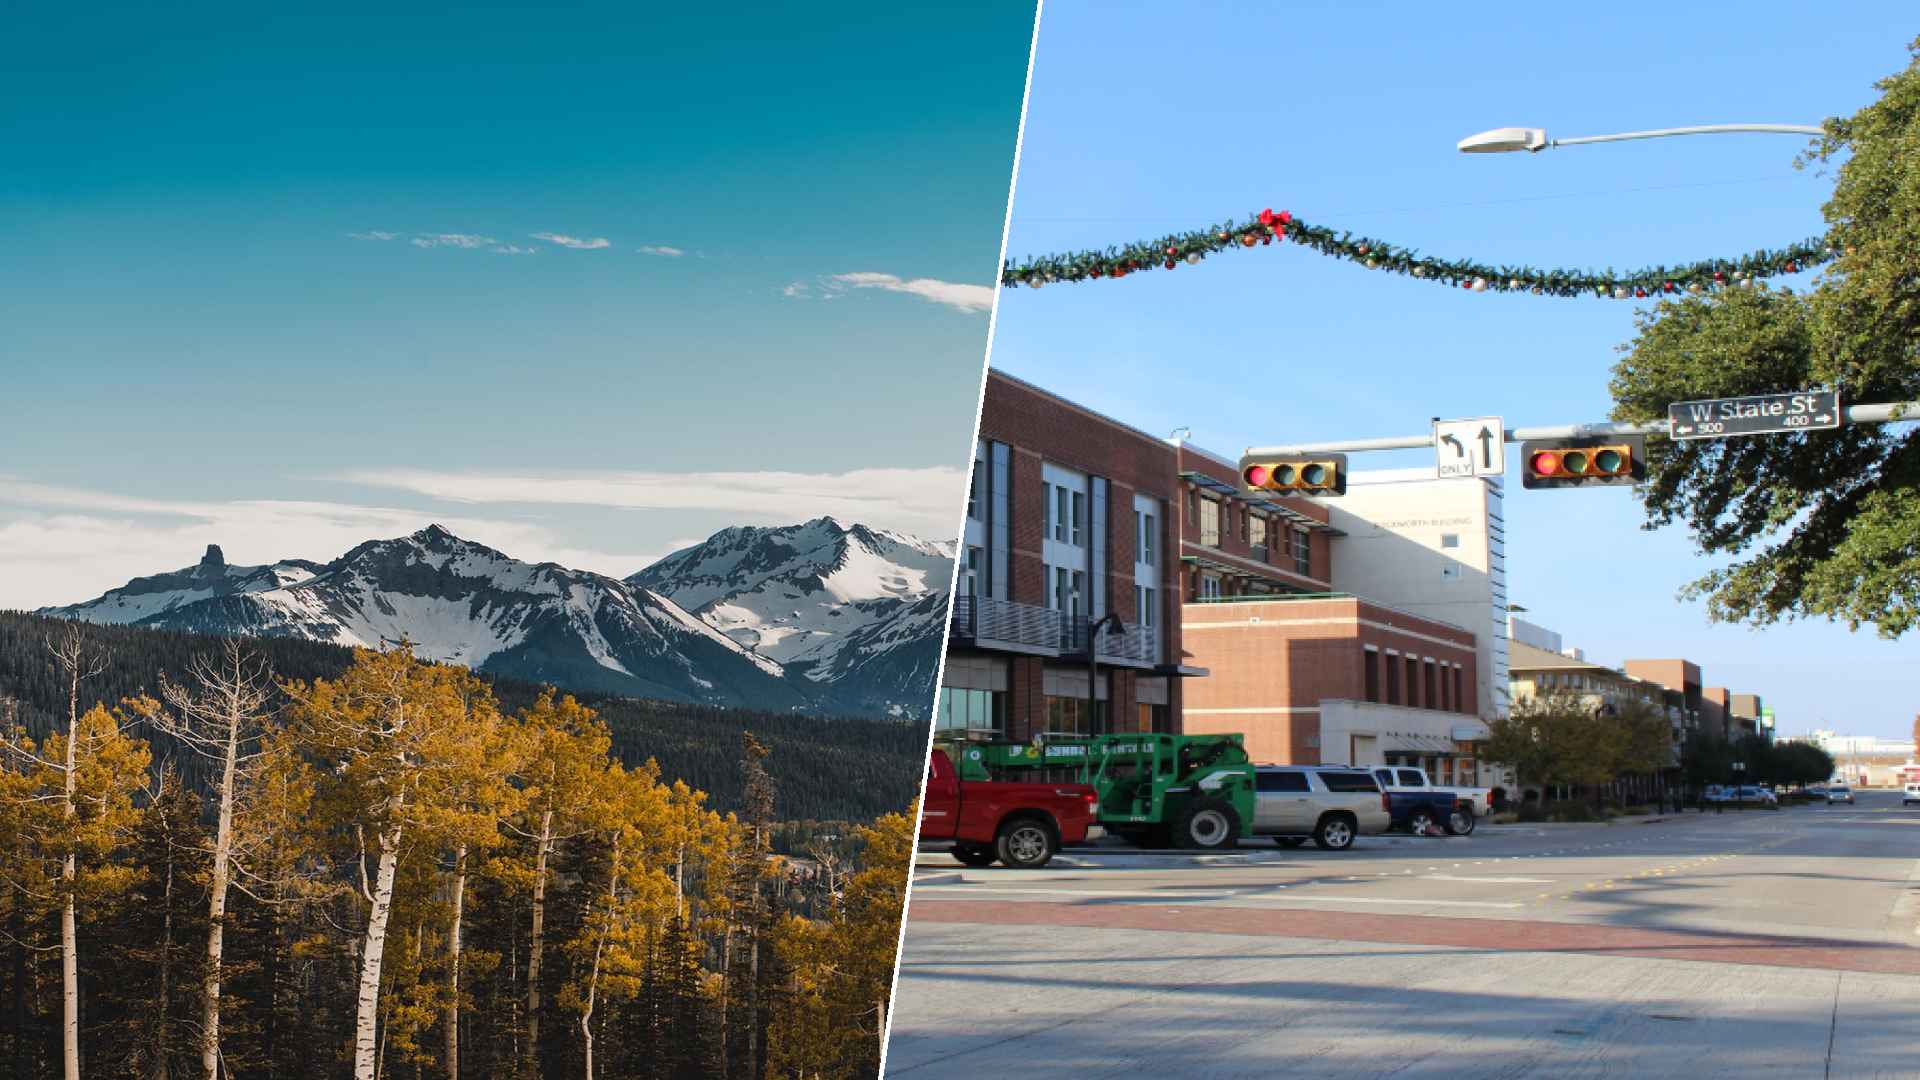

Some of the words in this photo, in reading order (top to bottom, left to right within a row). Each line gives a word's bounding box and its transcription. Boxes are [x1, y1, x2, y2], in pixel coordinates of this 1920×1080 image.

[1690, 405, 1712, 422] W
[1721, 402, 1784, 419] State
[1791, 396, 1816, 413] St
[1783, 415, 1809, 426] 400
[1440, 464, 1471, 474] ONLY
